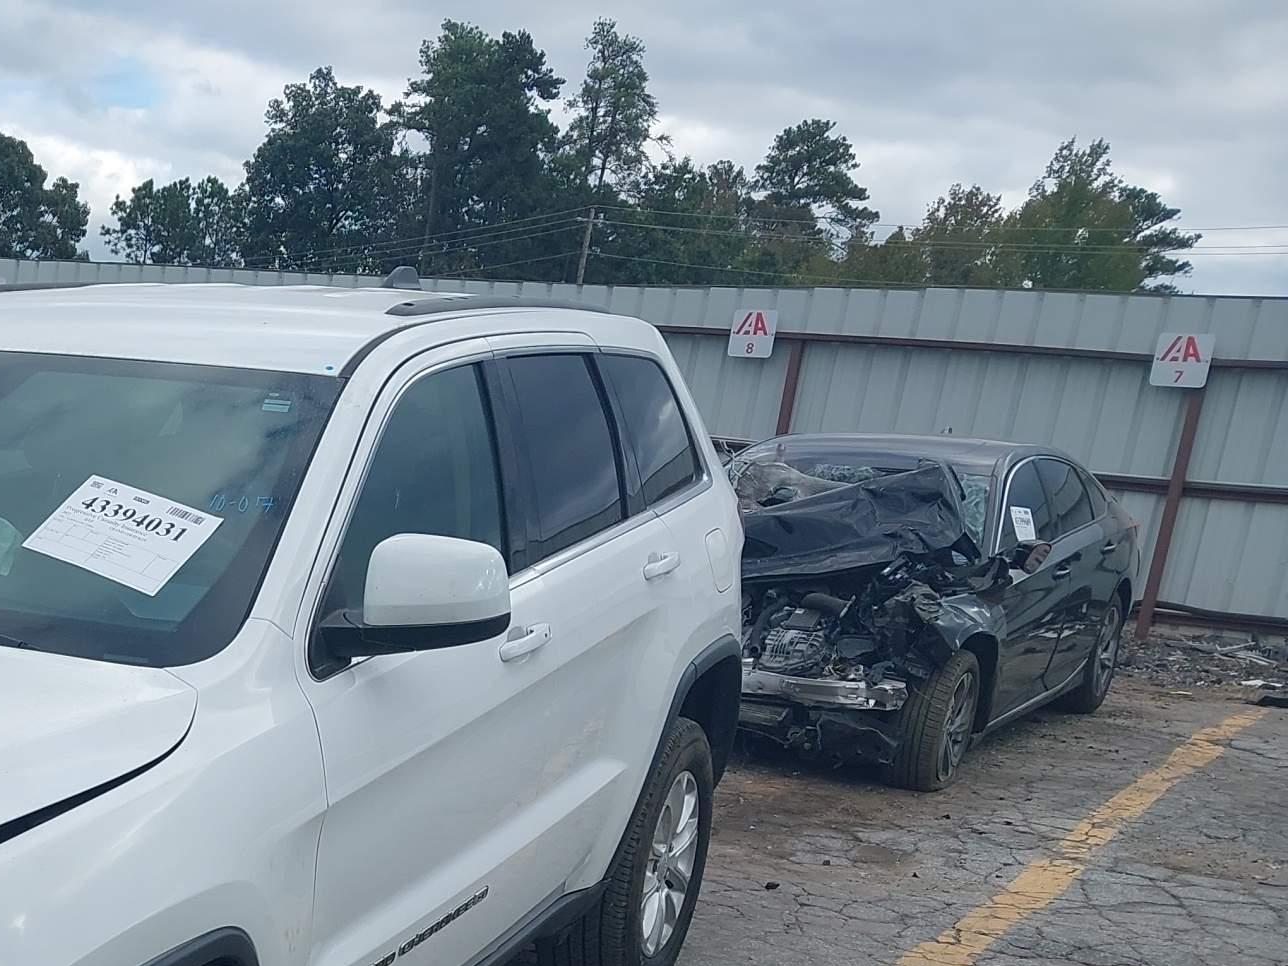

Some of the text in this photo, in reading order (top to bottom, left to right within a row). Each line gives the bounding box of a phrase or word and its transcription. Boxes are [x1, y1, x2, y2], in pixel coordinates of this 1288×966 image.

[745, 342, 755, 354] 8
[1173, 370, 1185, 383] 7
[81, 496, 189, 542] 43394031
